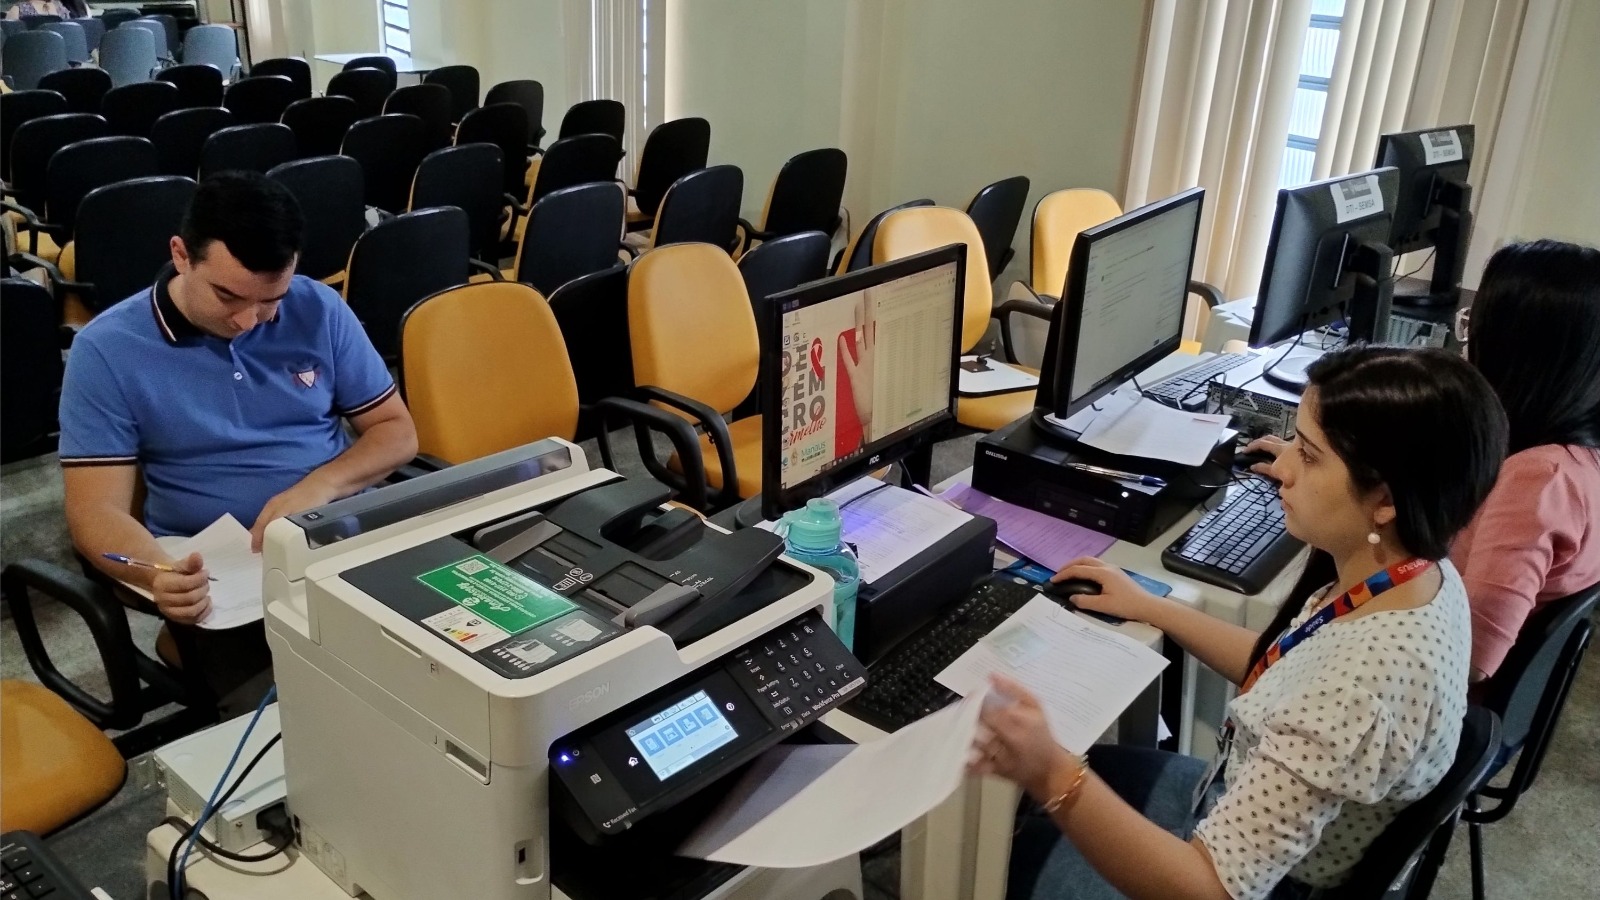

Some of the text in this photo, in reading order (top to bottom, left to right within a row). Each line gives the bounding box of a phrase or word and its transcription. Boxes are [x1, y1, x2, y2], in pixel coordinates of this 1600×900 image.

[869, 454, 880, 464] AOC
[985, 450, 1008, 461] POSITIVO
[568, 681, 610, 711] EPSON
